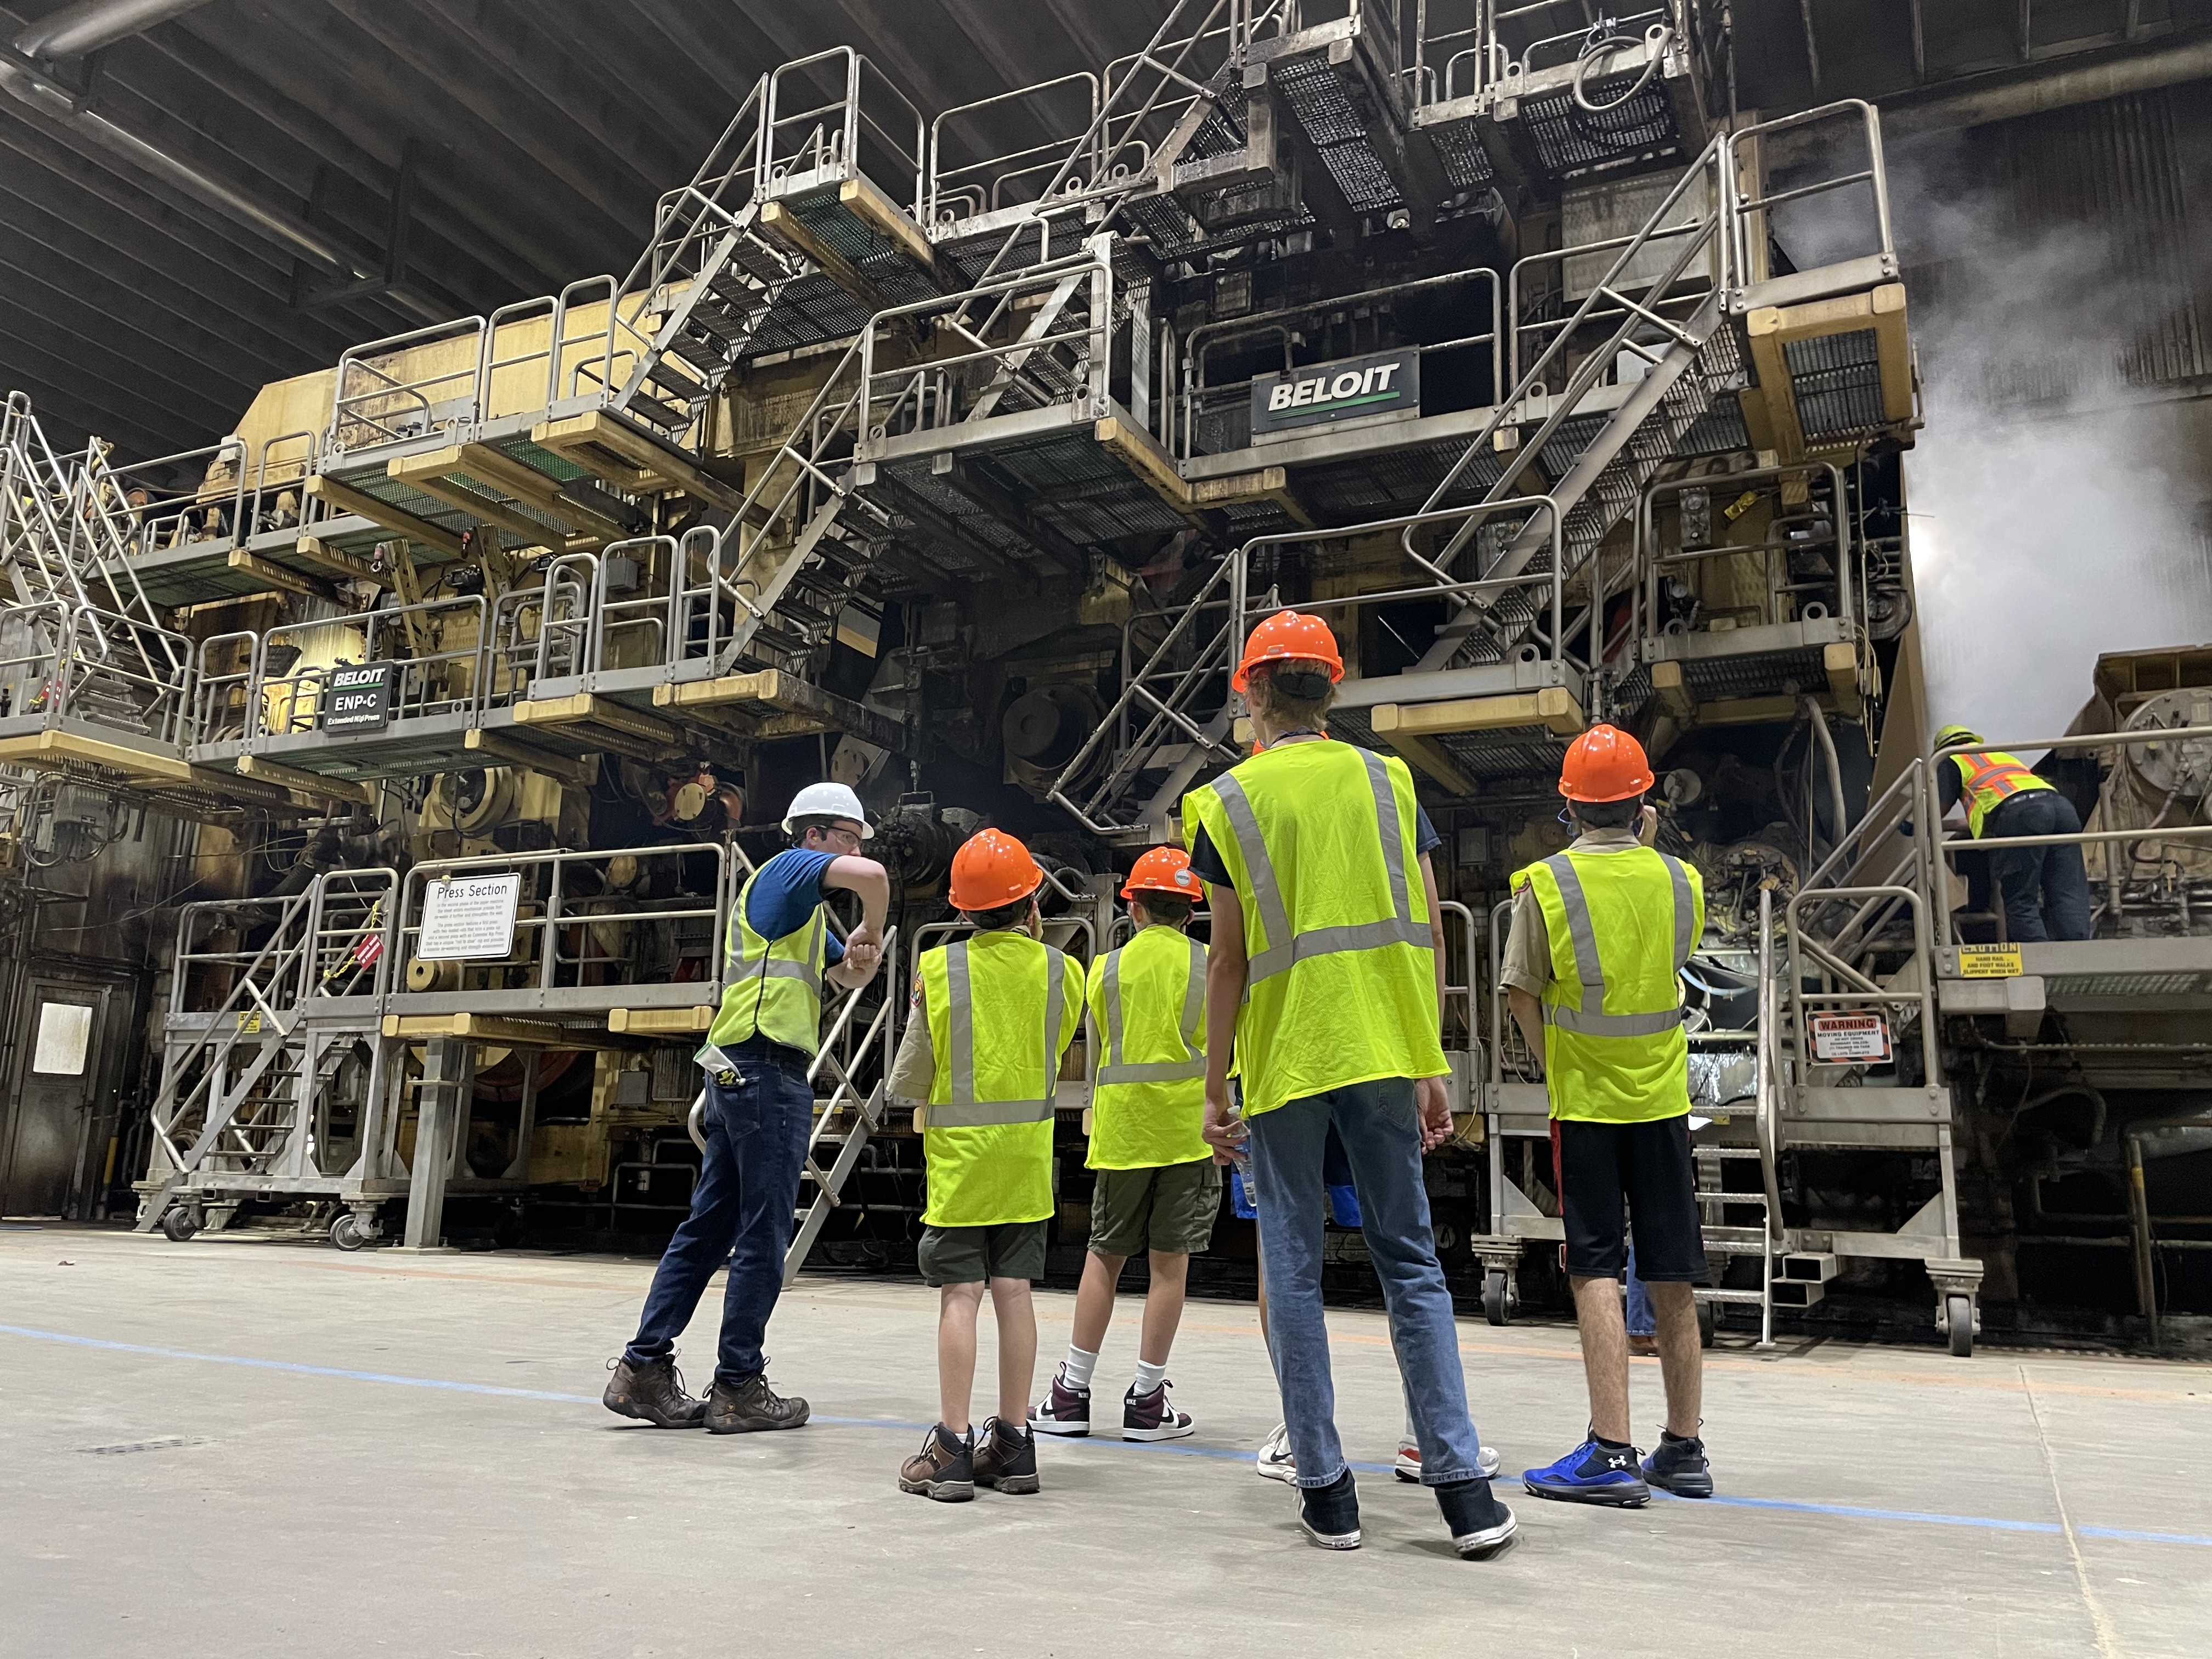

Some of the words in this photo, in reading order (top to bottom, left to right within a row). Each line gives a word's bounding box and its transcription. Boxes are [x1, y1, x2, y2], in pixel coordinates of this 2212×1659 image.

[1268, 363, 1400, 411] BELOIT
[333, 668, 386, 687] BELOIT
[335, 693, 377, 712] ENP-C
[327, 715, 354, 725] Extended
[354, 715, 364, 723] Nip
[437, 887, 464, 900] Press
[469, 883, 507, 897] Section
[1821, 1019, 1874, 1030] WARNING
